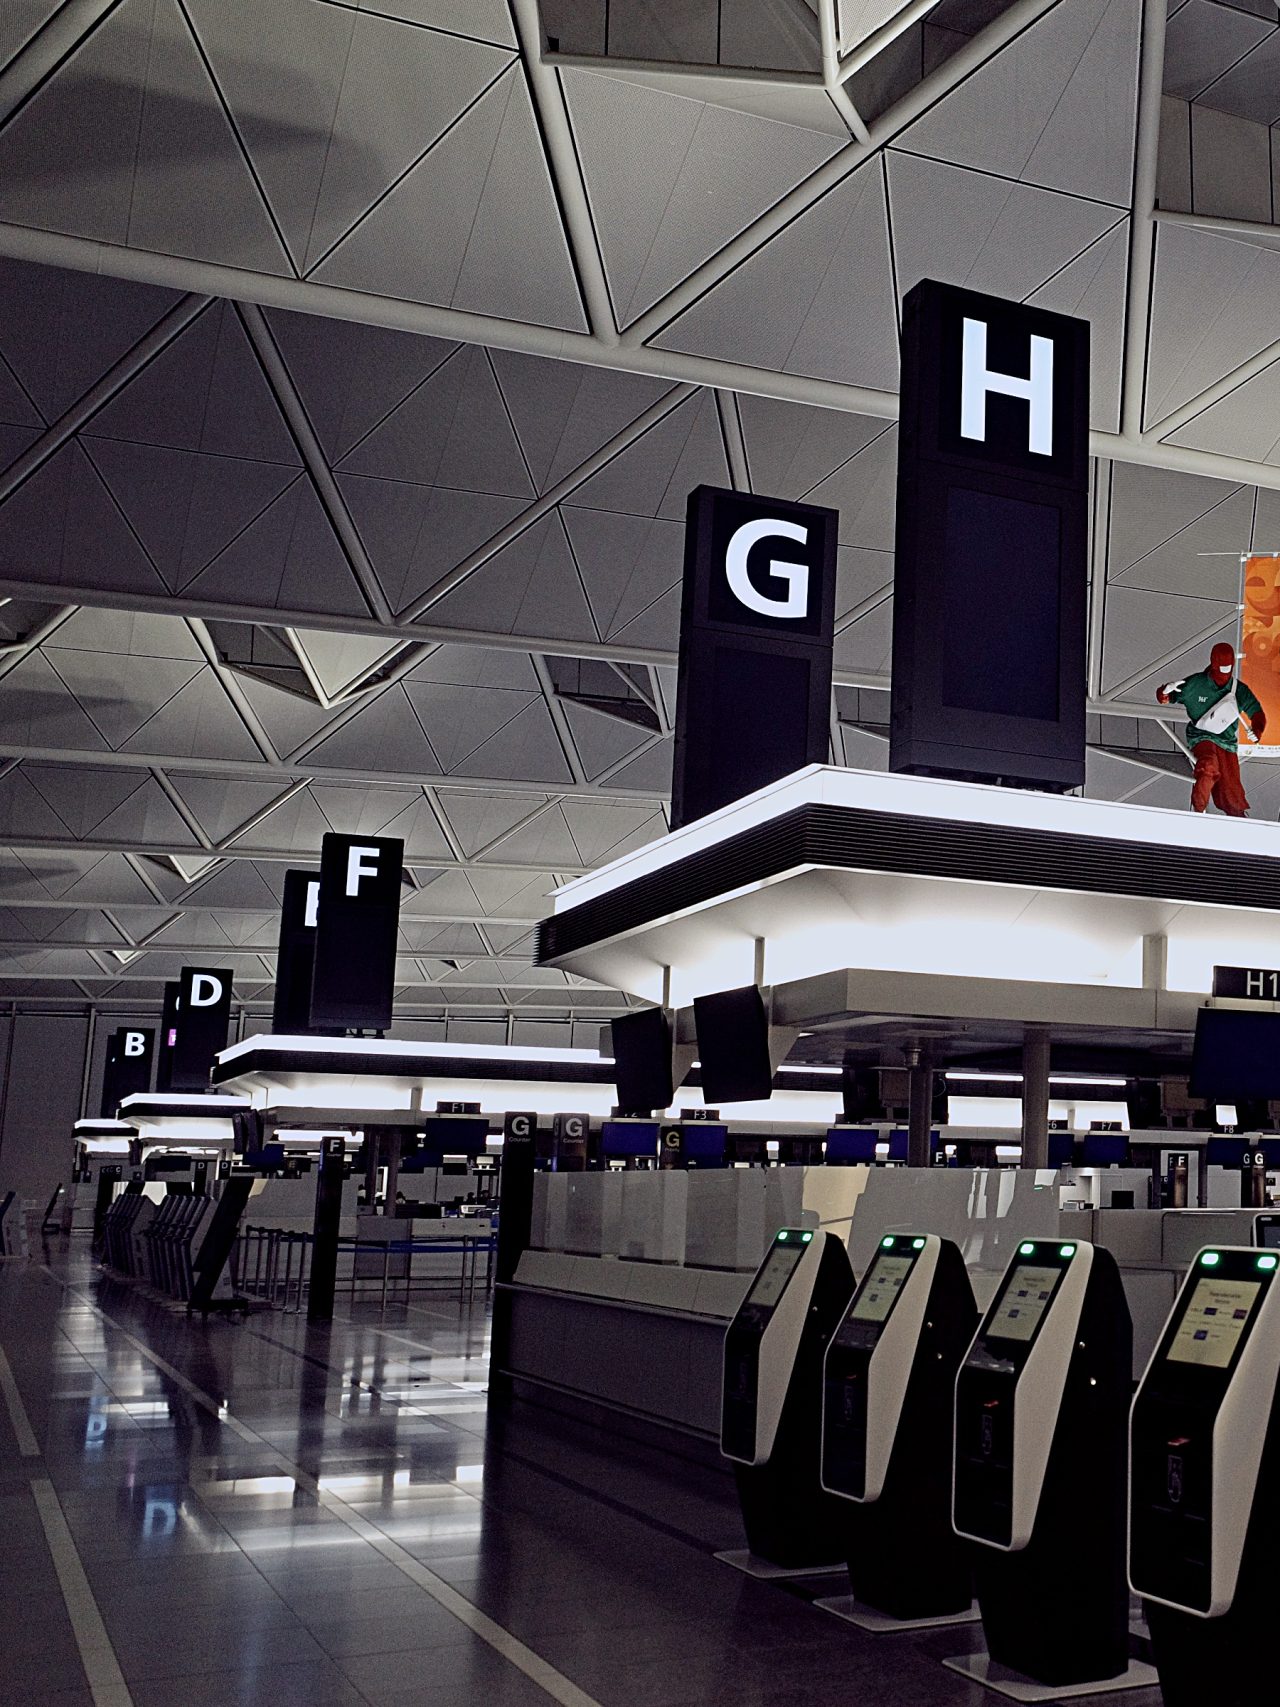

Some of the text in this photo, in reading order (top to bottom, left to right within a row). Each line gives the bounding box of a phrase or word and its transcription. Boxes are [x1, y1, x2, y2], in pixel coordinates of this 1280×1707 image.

[961, 317, 1054, 456] H
[725, 518, 809, 618] G
[345, 846, 380, 896] F
[190, 974, 223, 1007] D
[1246, 971, 1278, 998] H1
[125, 1032, 145, 1056] B
[452, 1103, 465, 1113] F1
[694, 1109, 707, 1120] F3
[511, 1116, 530, 1136] G
[566, 1118, 583, 1137] G
[1102, 1122, 1112, 1130] F7
[1224, 1125, 1234, 1134] F8
[330, 1139, 341, 1152] F
[666, 1131, 680, 1148] G
[936, 1152, 944, 1163] F
[1177, 1156, 1185, 1167] F
[1243, 1153, 1250, 1165] G
[1254, 1153, 1264, 1165] G
